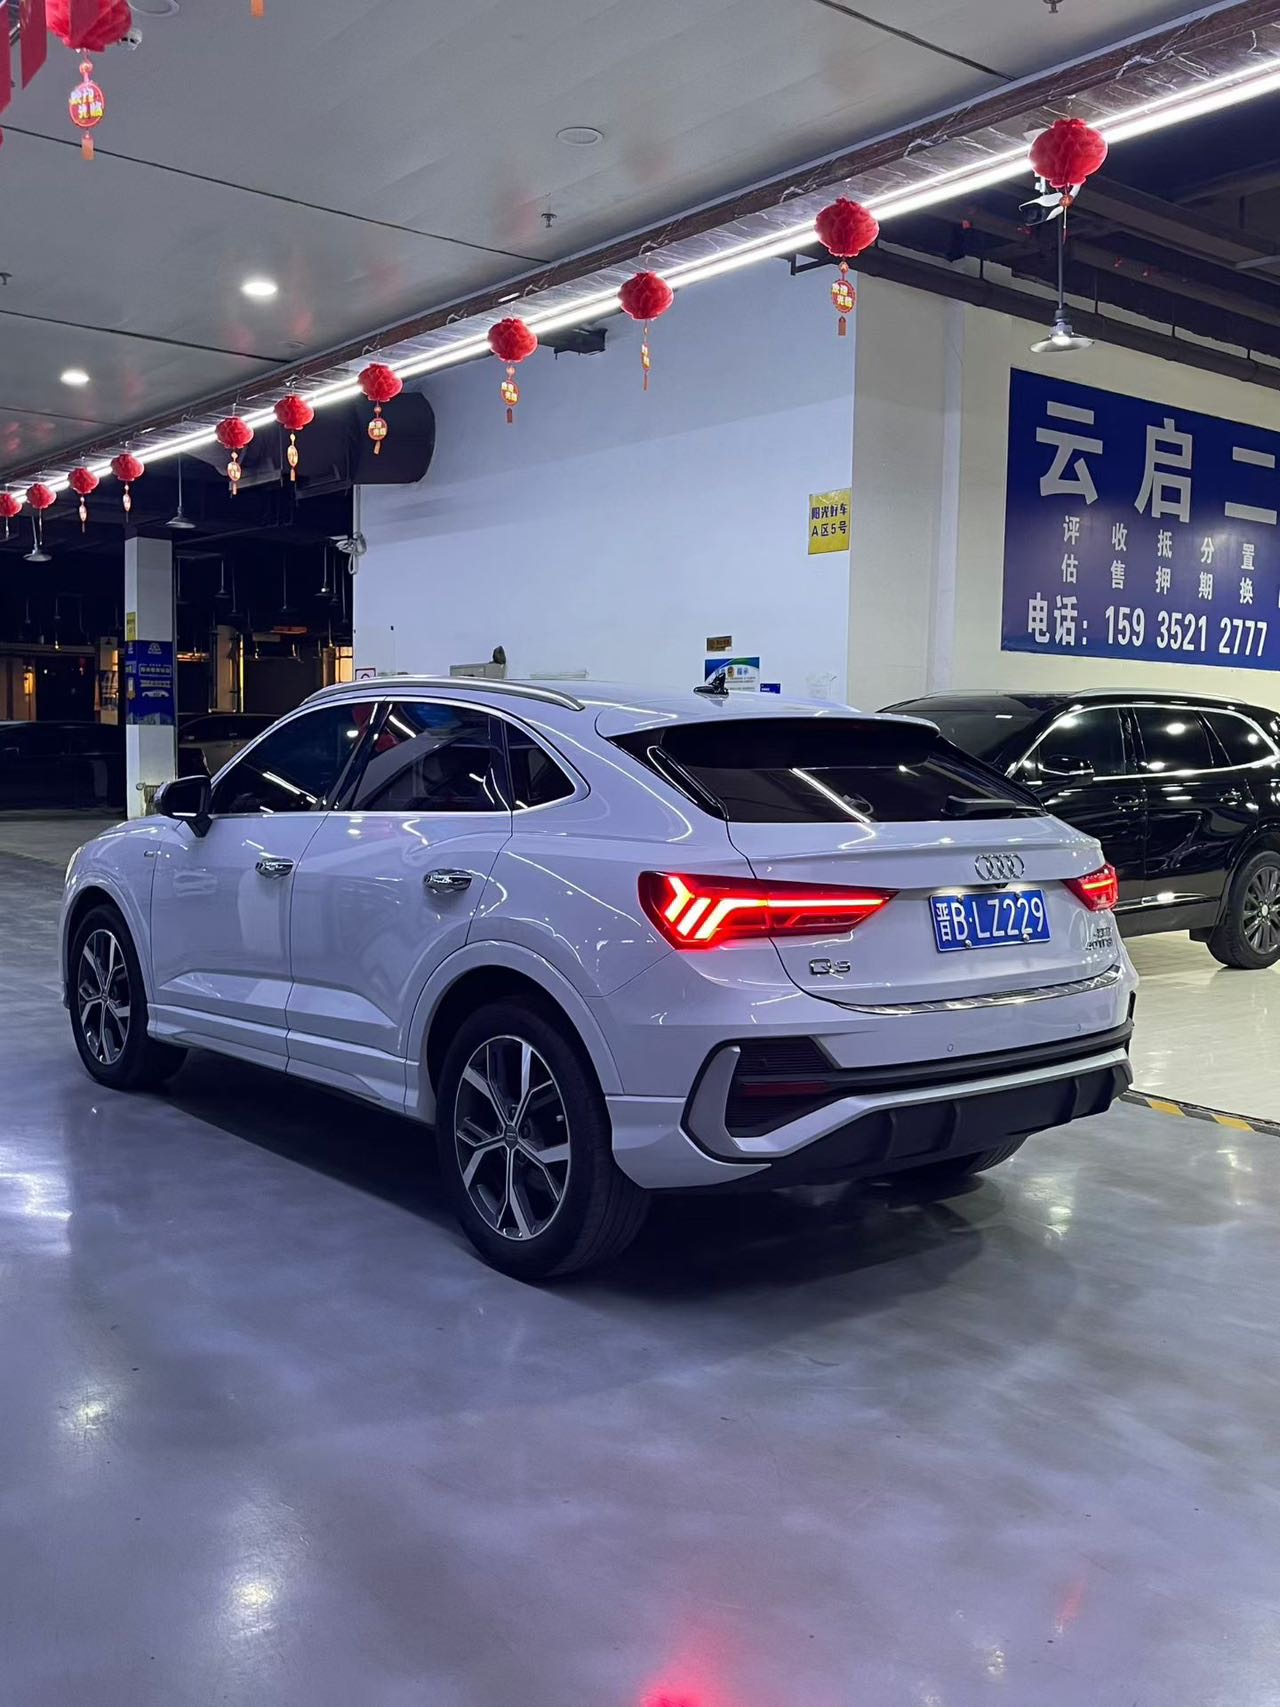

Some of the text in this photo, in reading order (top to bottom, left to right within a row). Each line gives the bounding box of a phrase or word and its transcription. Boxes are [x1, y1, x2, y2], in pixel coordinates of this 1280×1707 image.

[1036, 400, 1278, 526] 云启二
[811, 520, 848, 537] A区5号
[1062, 515, 1080, 584] 评估
[1110, 522, 1128, 590] 收售
[1155, 529, 1173, 595] 抵押
[1198, 536, 1215, 601] 分期
[1239, 543, 1255, 605] 置换
[1105, 604, 1145, 647] 159
[1156, 609, 1208, 652] 3521
[1218, 616, 1268, 657] 2777
